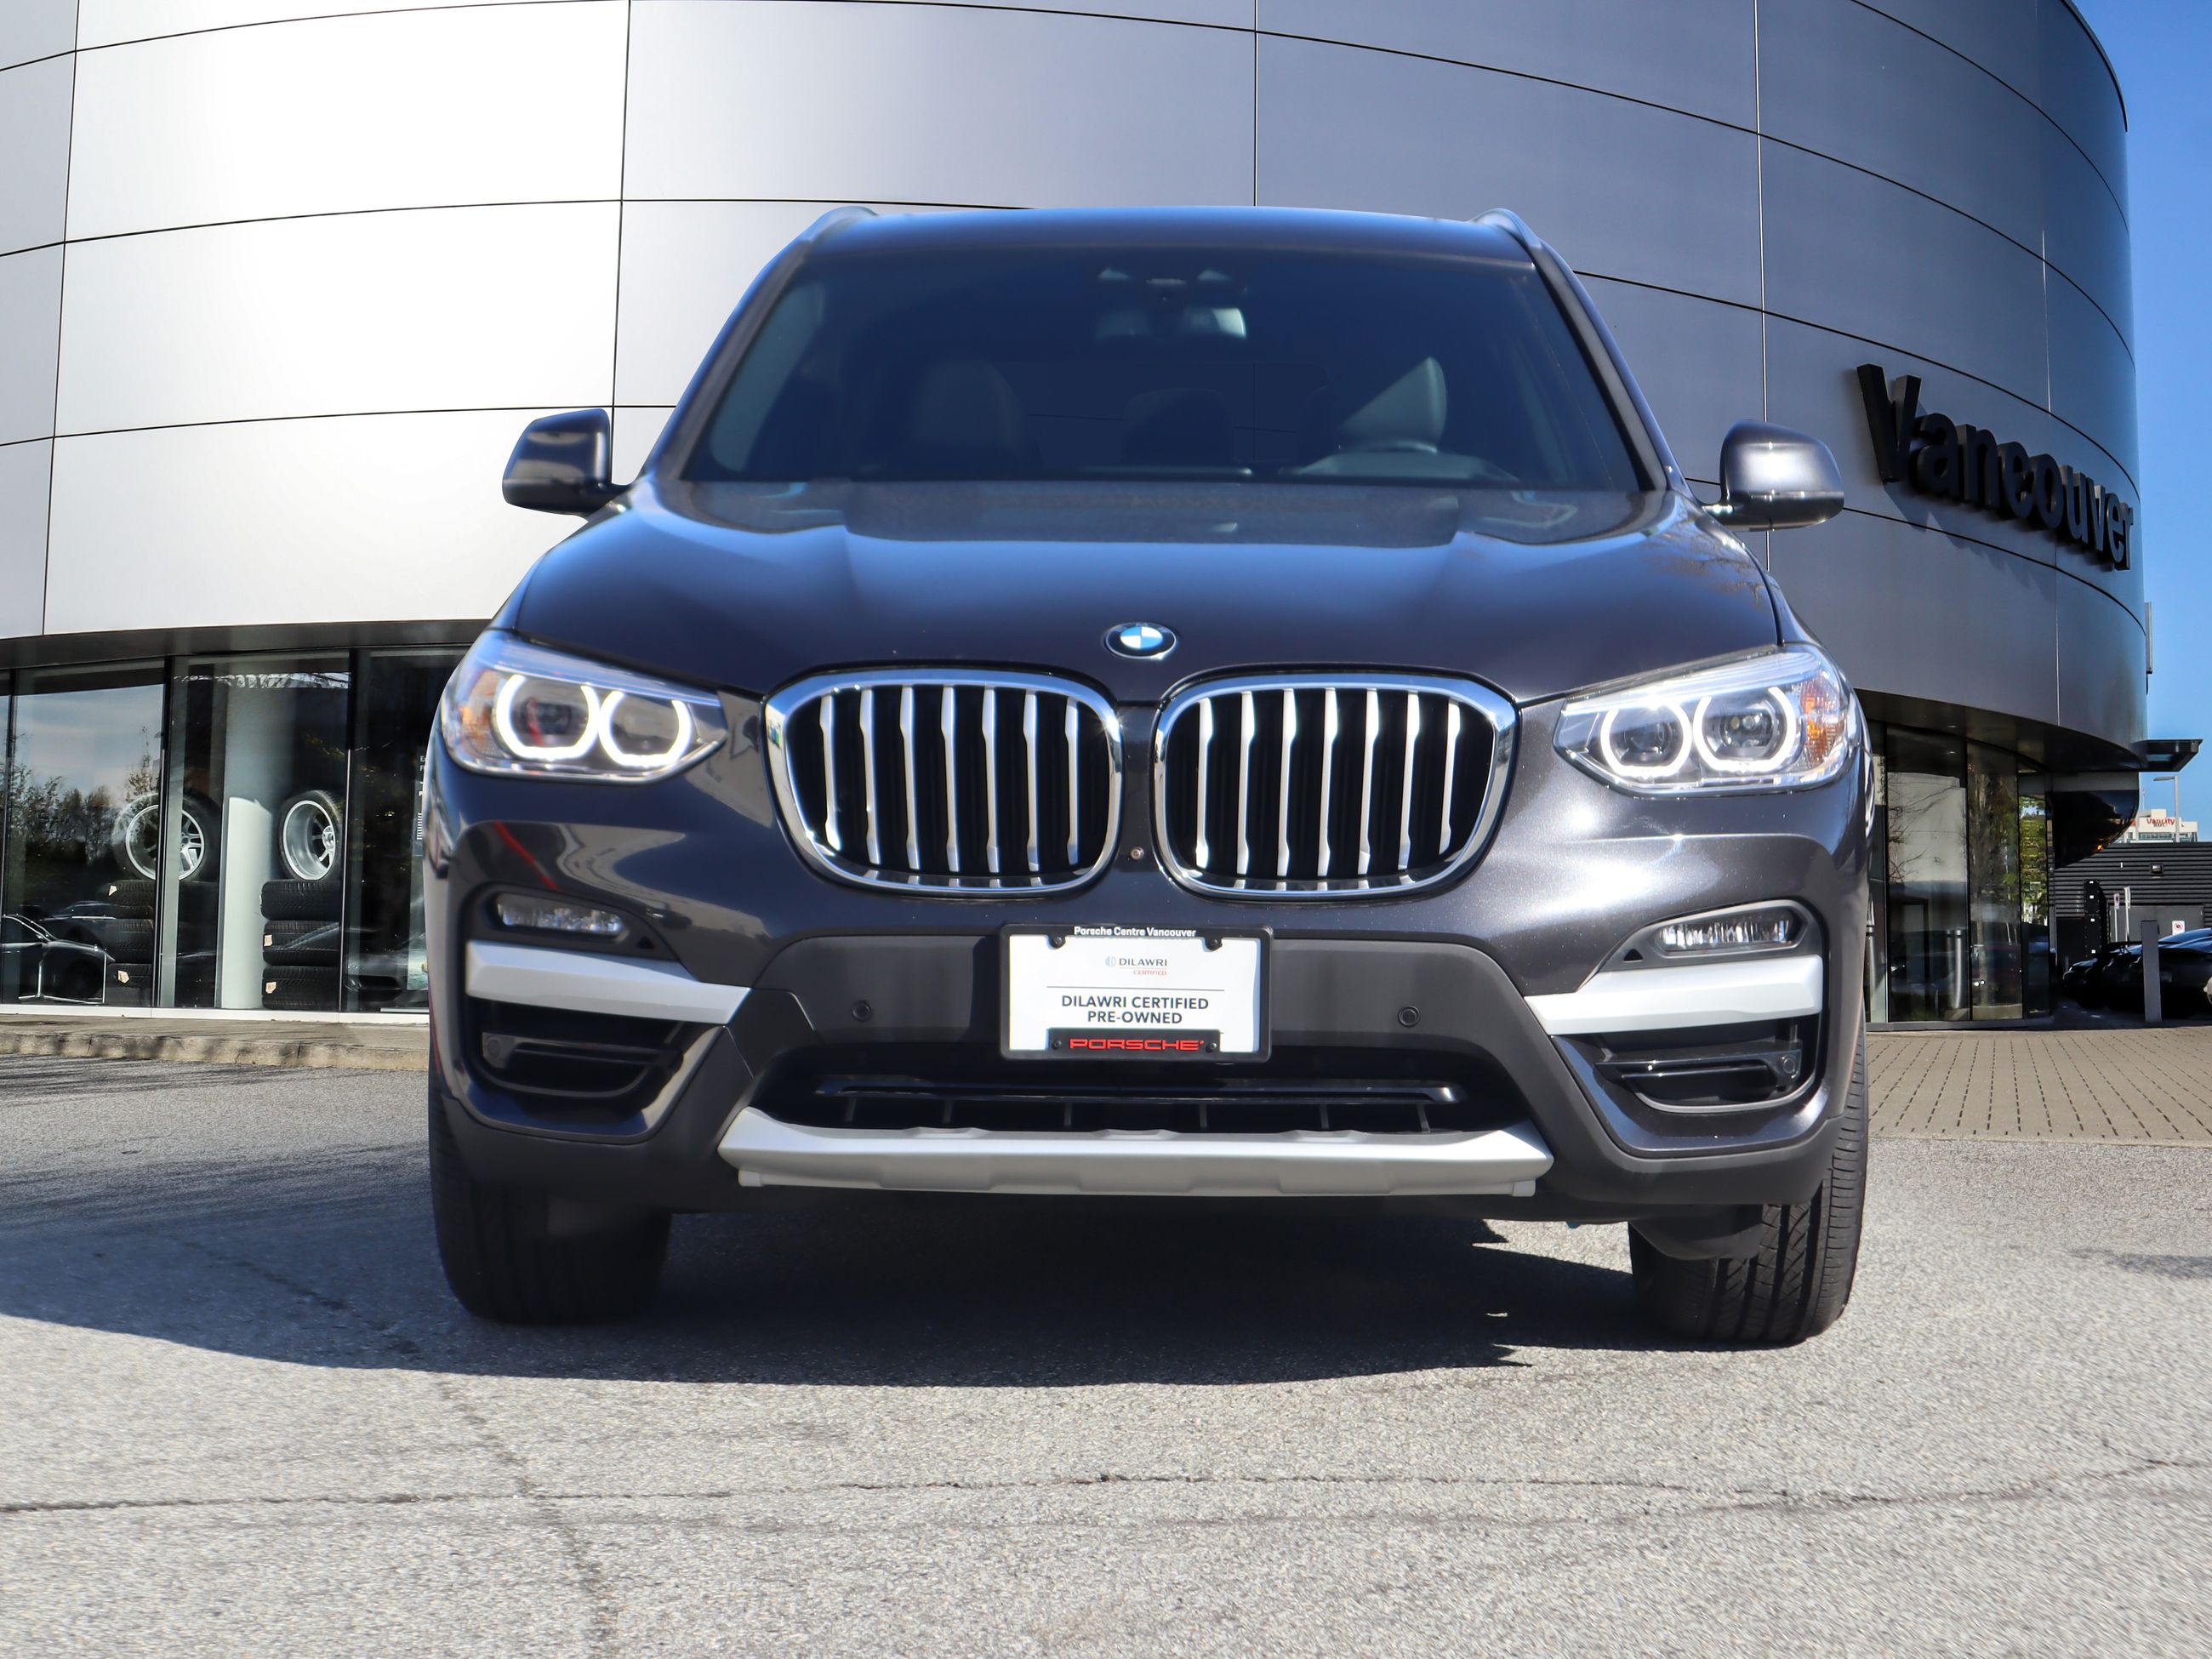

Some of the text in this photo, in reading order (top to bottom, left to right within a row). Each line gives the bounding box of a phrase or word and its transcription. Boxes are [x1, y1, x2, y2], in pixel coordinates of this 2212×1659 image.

[1856, 363, 2133, 570] Vancouver
[1074, 926, 1196, 937] Porsche Centre Vancouver
[1119, 958, 1167, 966] DILAWRI
[1062, 995, 1209, 1010] DILAWRI CERTIFIED
[1087, 1011, 1183, 1024] PRE-OWNED
[1069, 1038, 1199, 1051] PORSCHE
